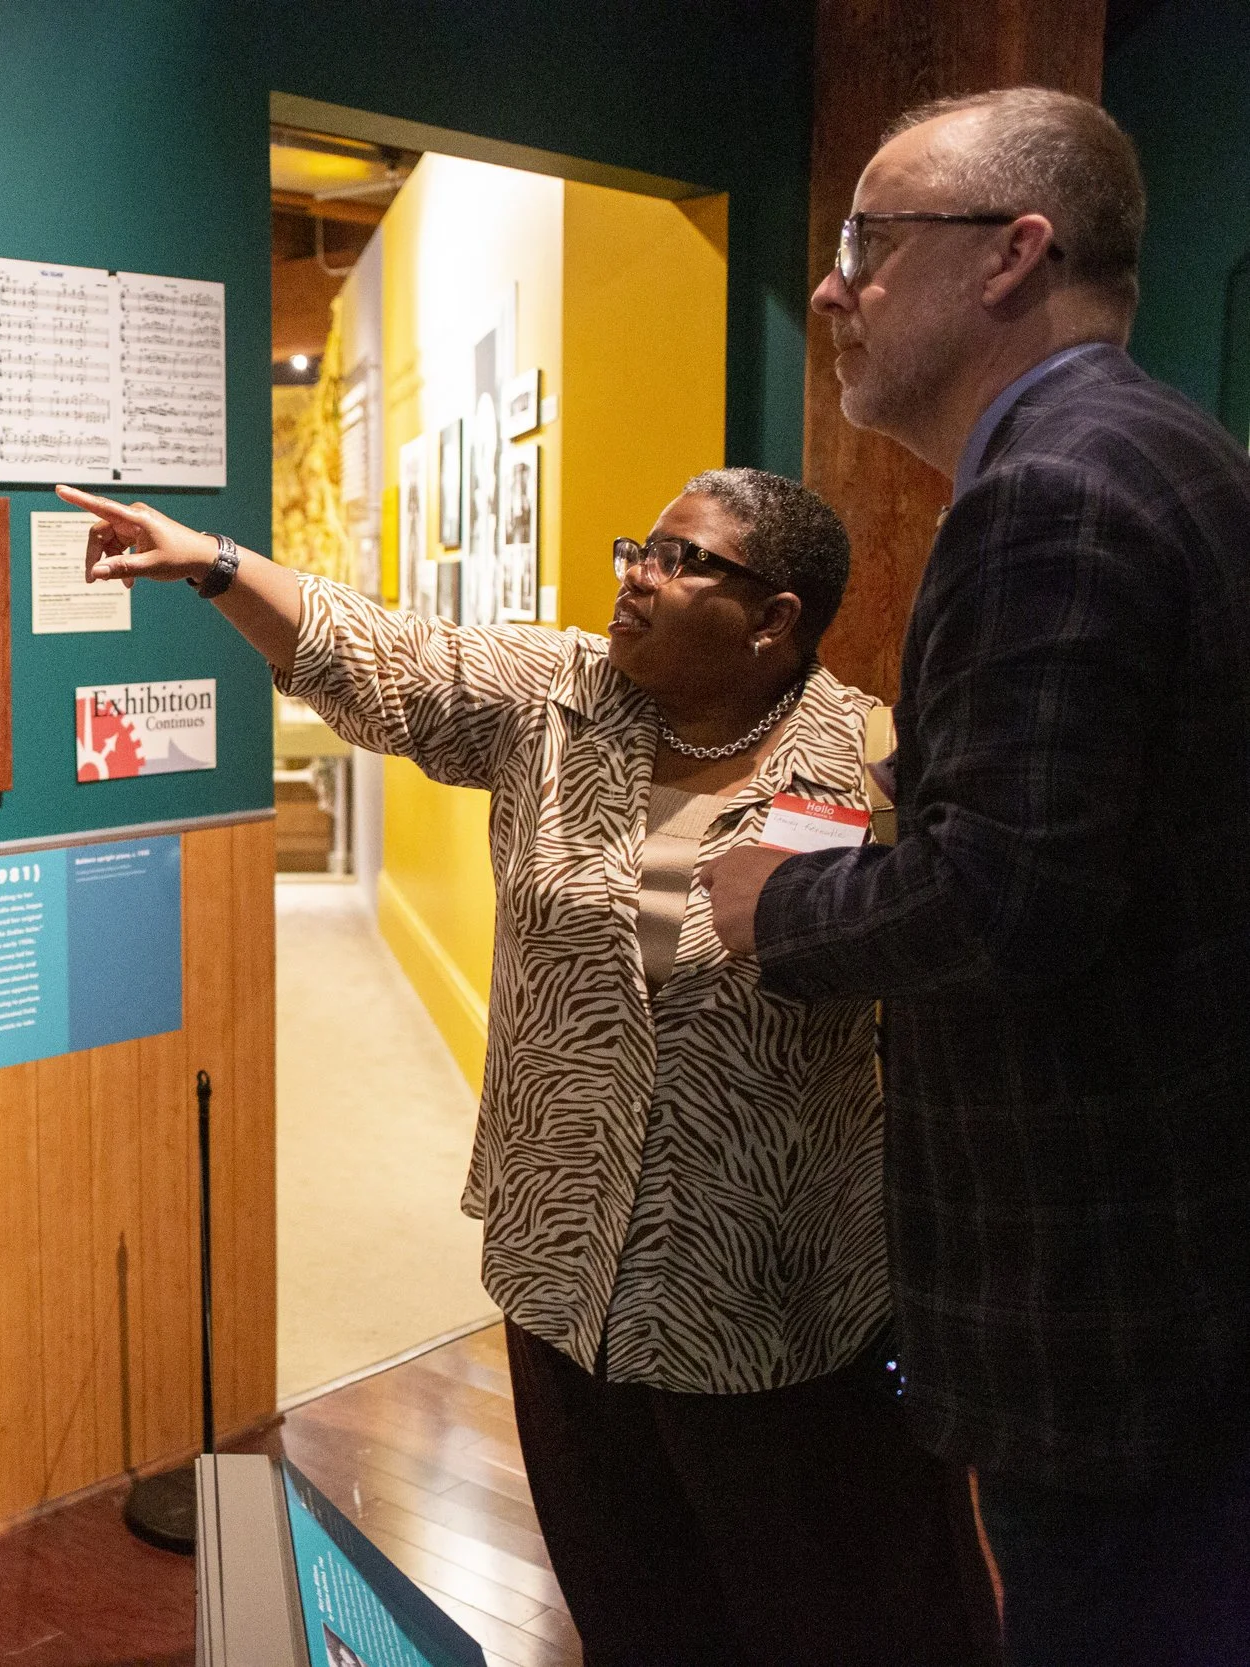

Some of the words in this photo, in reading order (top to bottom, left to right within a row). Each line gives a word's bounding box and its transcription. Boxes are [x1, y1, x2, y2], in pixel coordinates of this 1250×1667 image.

[92, 685, 212, 717] Exhibition
[145, 715, 205, 732] Continues
[806, 802, 834, 815] Hello
